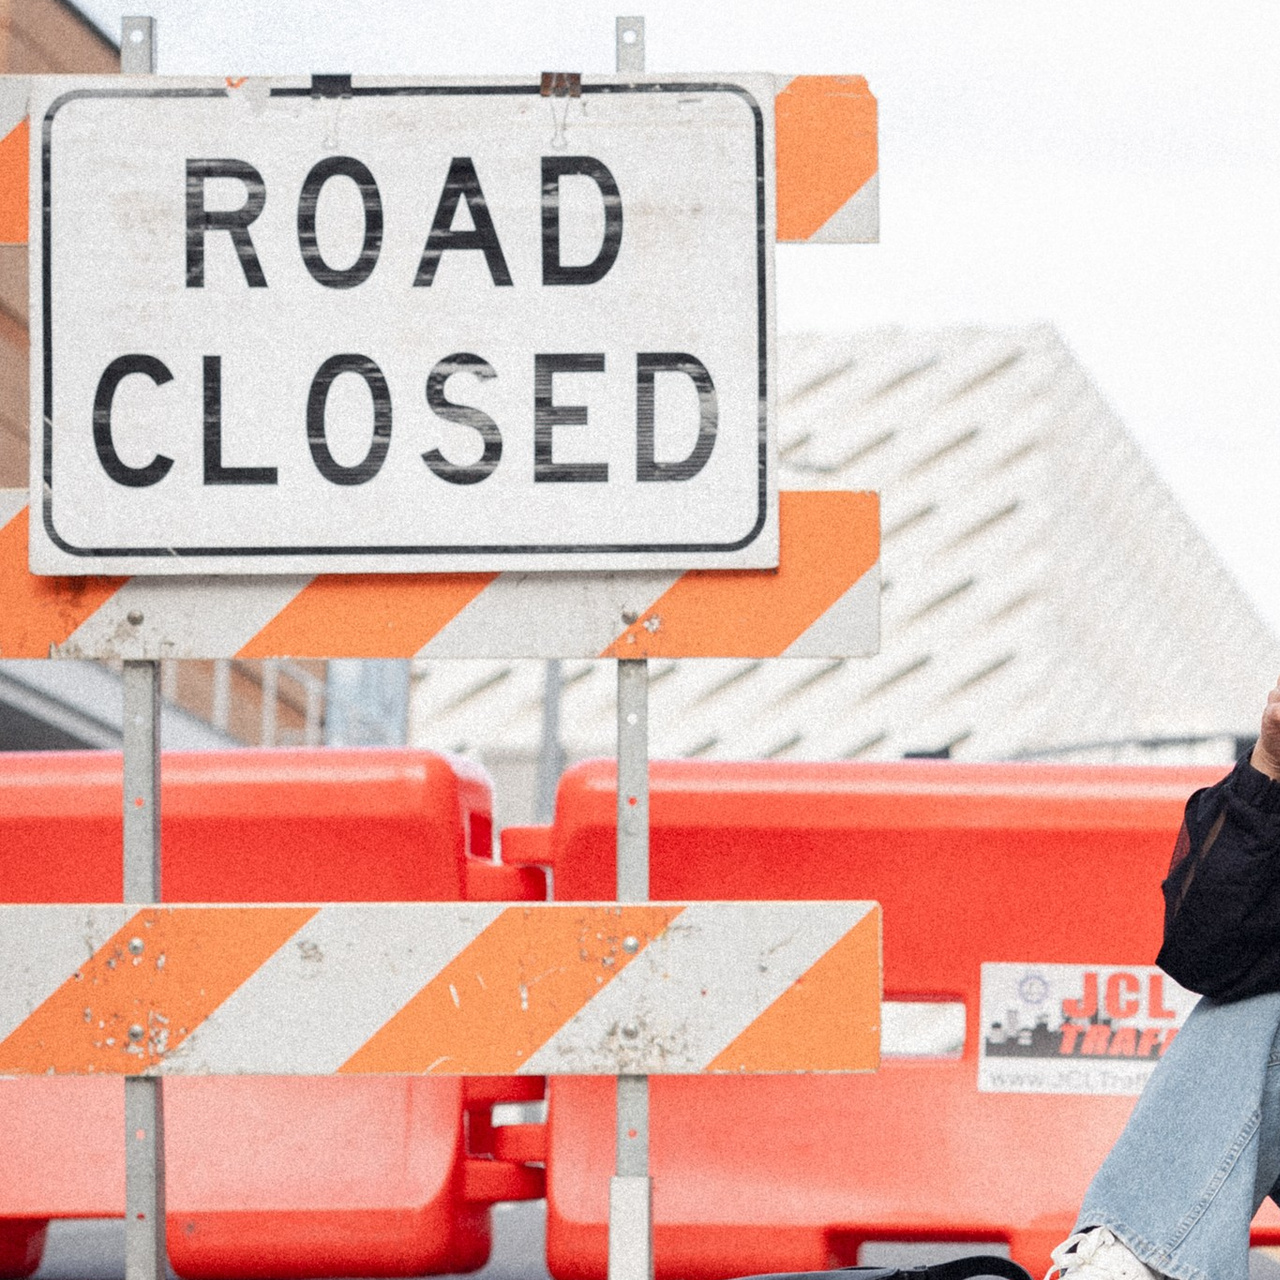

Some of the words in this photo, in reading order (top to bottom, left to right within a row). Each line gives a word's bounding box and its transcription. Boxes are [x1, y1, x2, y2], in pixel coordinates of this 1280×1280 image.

[184, 155, 624, 289] ROAD
[91, 352, 720, 488] CLOSED
[1062, 972, 1176, 1019] JCL
